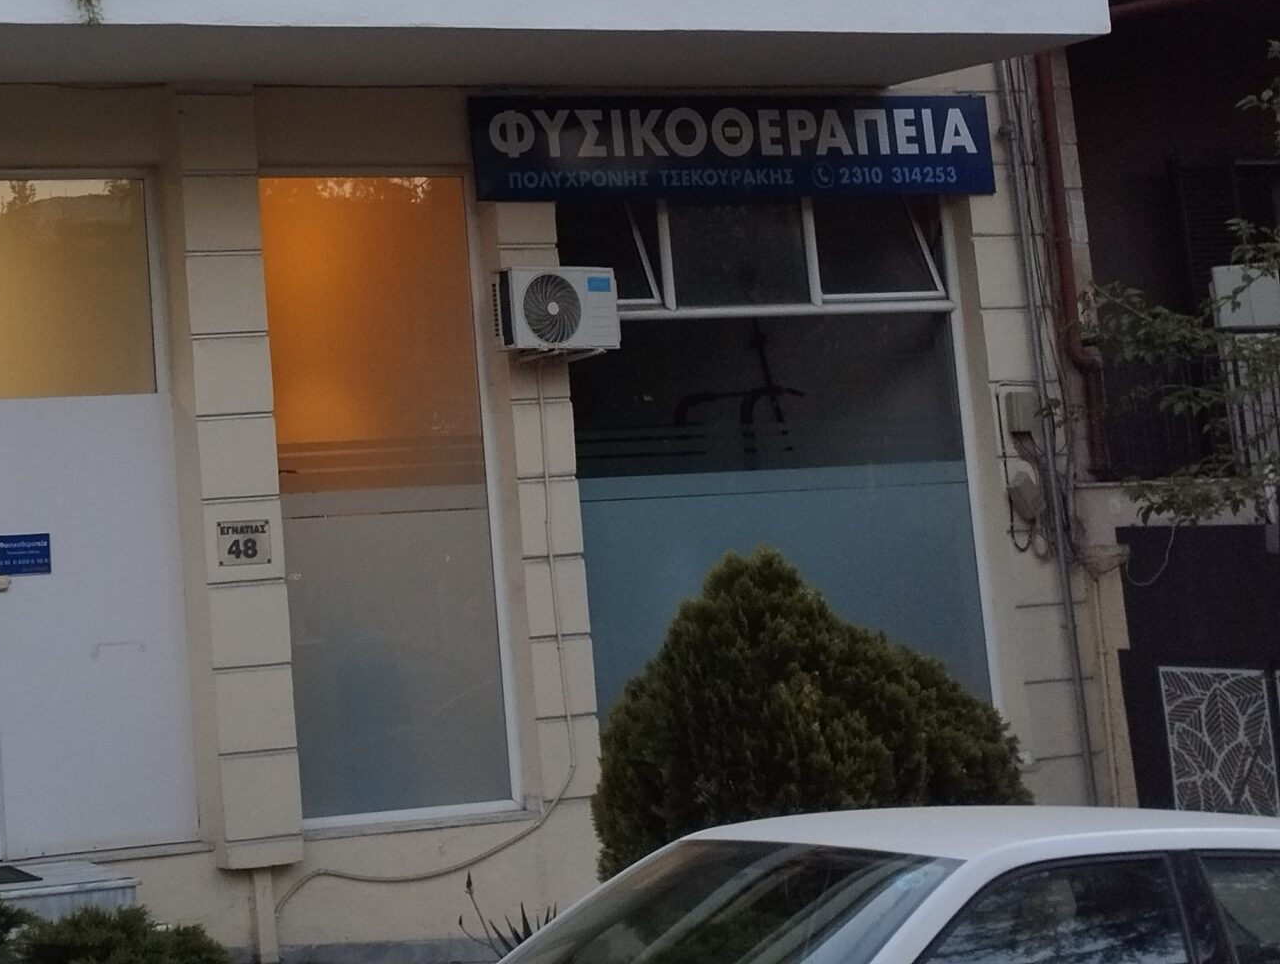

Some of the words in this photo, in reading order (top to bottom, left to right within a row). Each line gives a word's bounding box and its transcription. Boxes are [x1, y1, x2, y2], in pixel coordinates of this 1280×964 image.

[488, 107, 978, 158] ΦΥΣΙΚΟΘΕΡΑΠΕΙΑ
[508, 170, 649, 189] ΠΟΛΥΧΡΟΝΗΣ
[660, 168, 794, 187] ΤΣΕΚΟΥΡΑΚΗΣ
[839, 166, 883, 184] 2310
[892, 166, 958, 183] 314253
[220, 524, 267, 535] ΕΓΝΑΤΙΑΣ
[227, 538, 258, 559] 48
